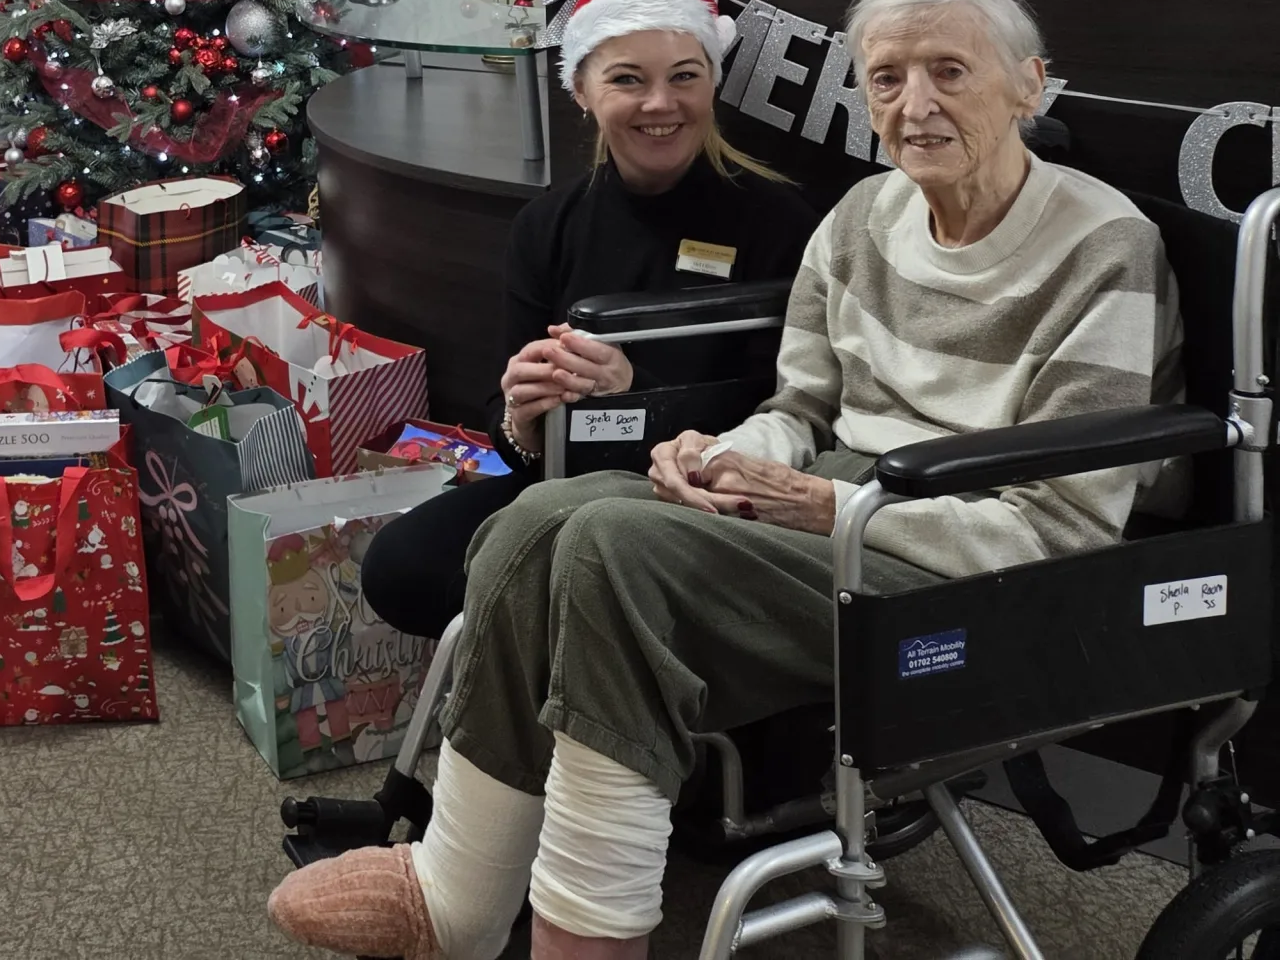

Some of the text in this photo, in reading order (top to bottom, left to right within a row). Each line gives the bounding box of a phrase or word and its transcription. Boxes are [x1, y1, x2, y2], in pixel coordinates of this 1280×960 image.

[585, 412, 611, 425] Sheila
[21, 433, 50, 445] 500
[1160, 583, 1223, 603] Sheila Room
[291, 622, 436, 682] Christm
[907, 640, 965, 659] All Terrain Mobility
[908, 651, 958, 668] 01702 540800
